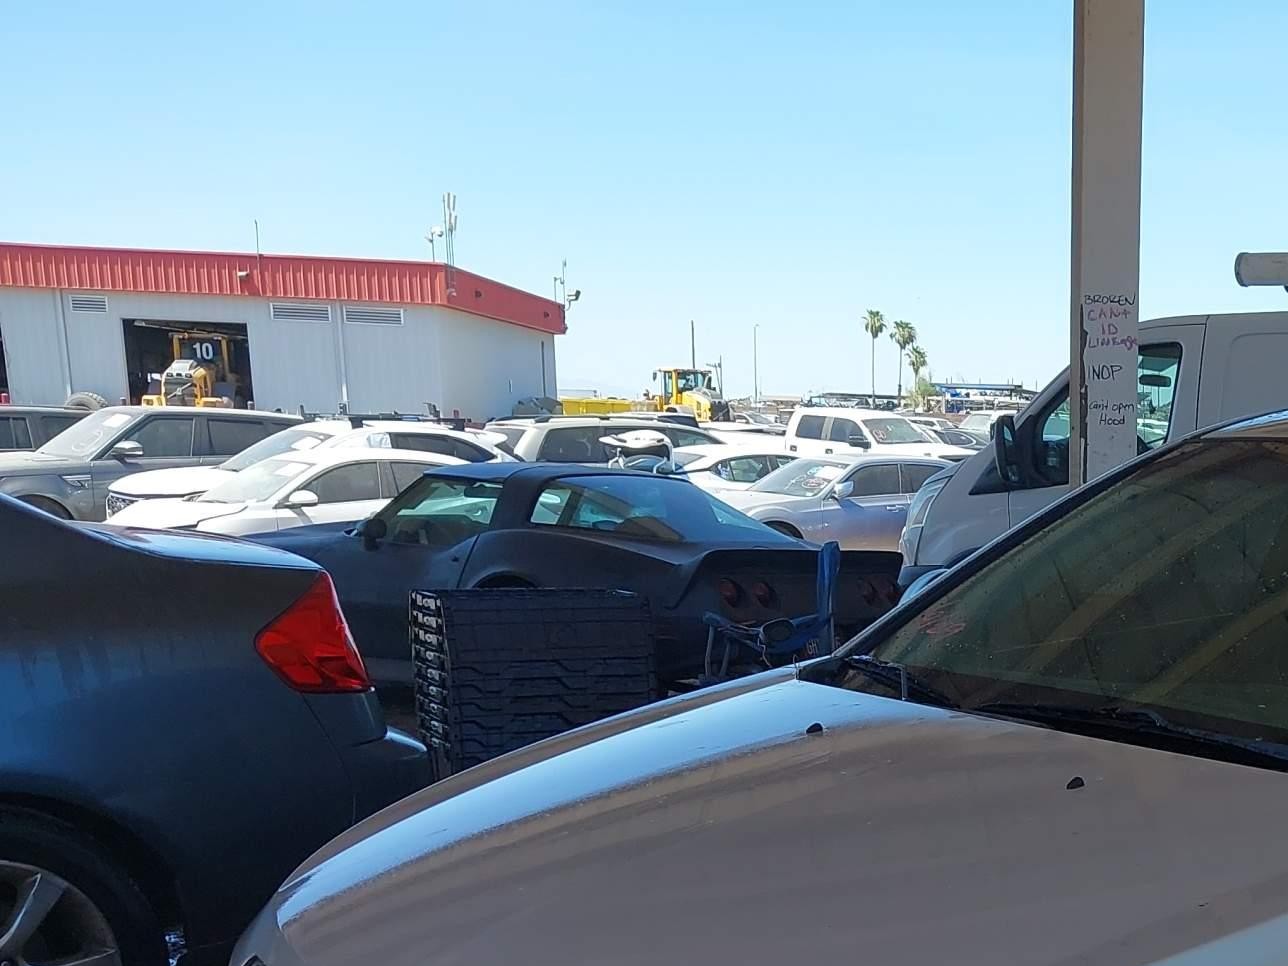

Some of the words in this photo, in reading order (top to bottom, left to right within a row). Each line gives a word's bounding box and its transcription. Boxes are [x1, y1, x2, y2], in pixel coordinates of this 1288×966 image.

[1084, 292, 1136, 306] BROKEN
[1101, 322, 1119, 335] ID
[193, 342, 214, 360] 10
[1088, 364, 1122, 381] INOP
[1099, 412, 1125, 426] Hood
